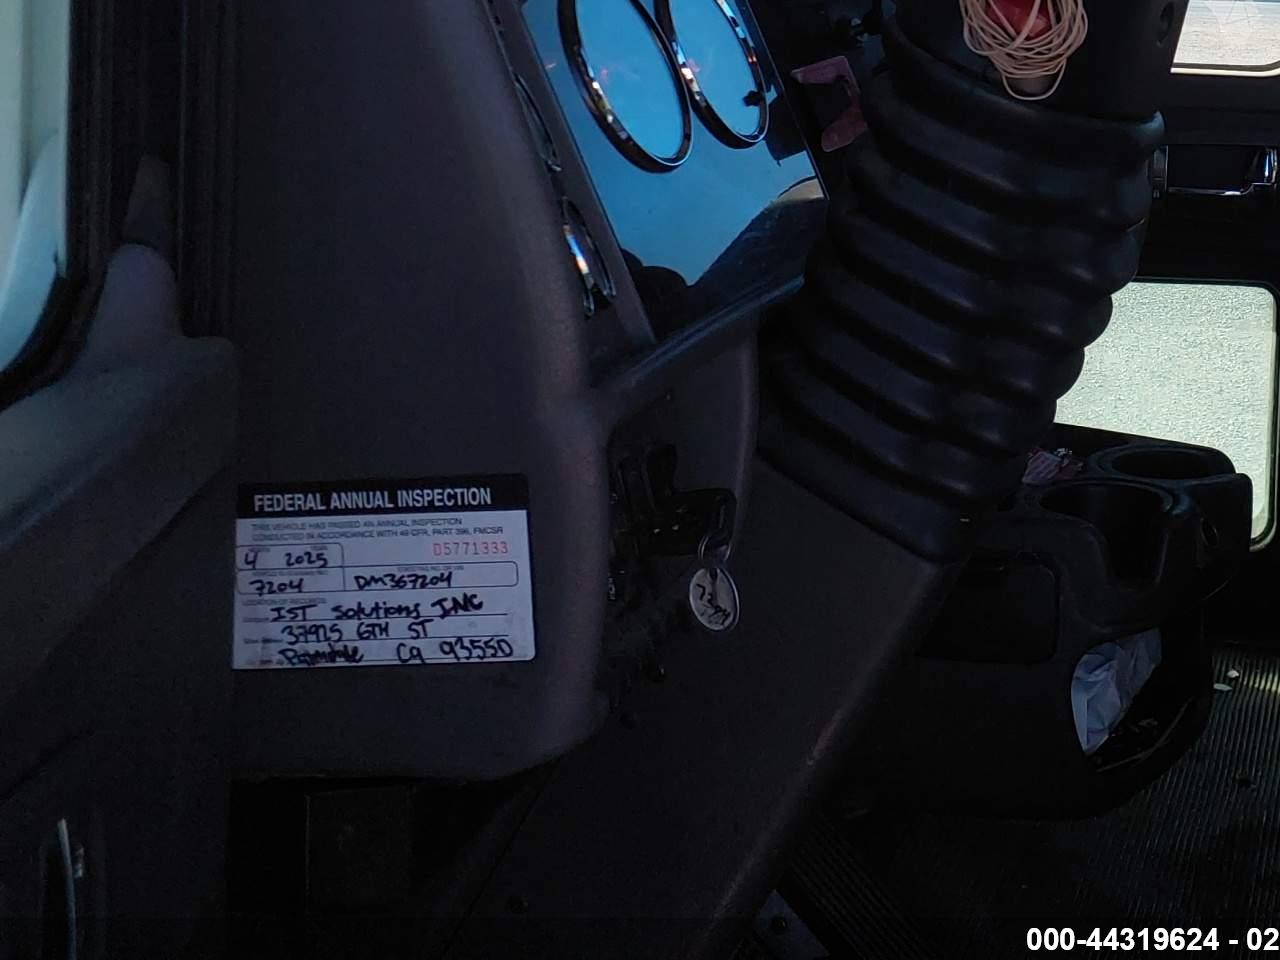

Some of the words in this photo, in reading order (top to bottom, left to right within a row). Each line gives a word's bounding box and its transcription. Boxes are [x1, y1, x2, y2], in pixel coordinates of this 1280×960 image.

[253, 492, 327, 513] FEDERAL
[329, 489, 395, 510] ANNUAL
[396, 487, 493, 509] INSPECTION
[244, 549, 258, 570] 4
[285, 551, 328, 568] 2025
[249, 578, 304, 596] 7204
[408, 619, 434, 639] ST
[439, 637, 513, 661] 93550
